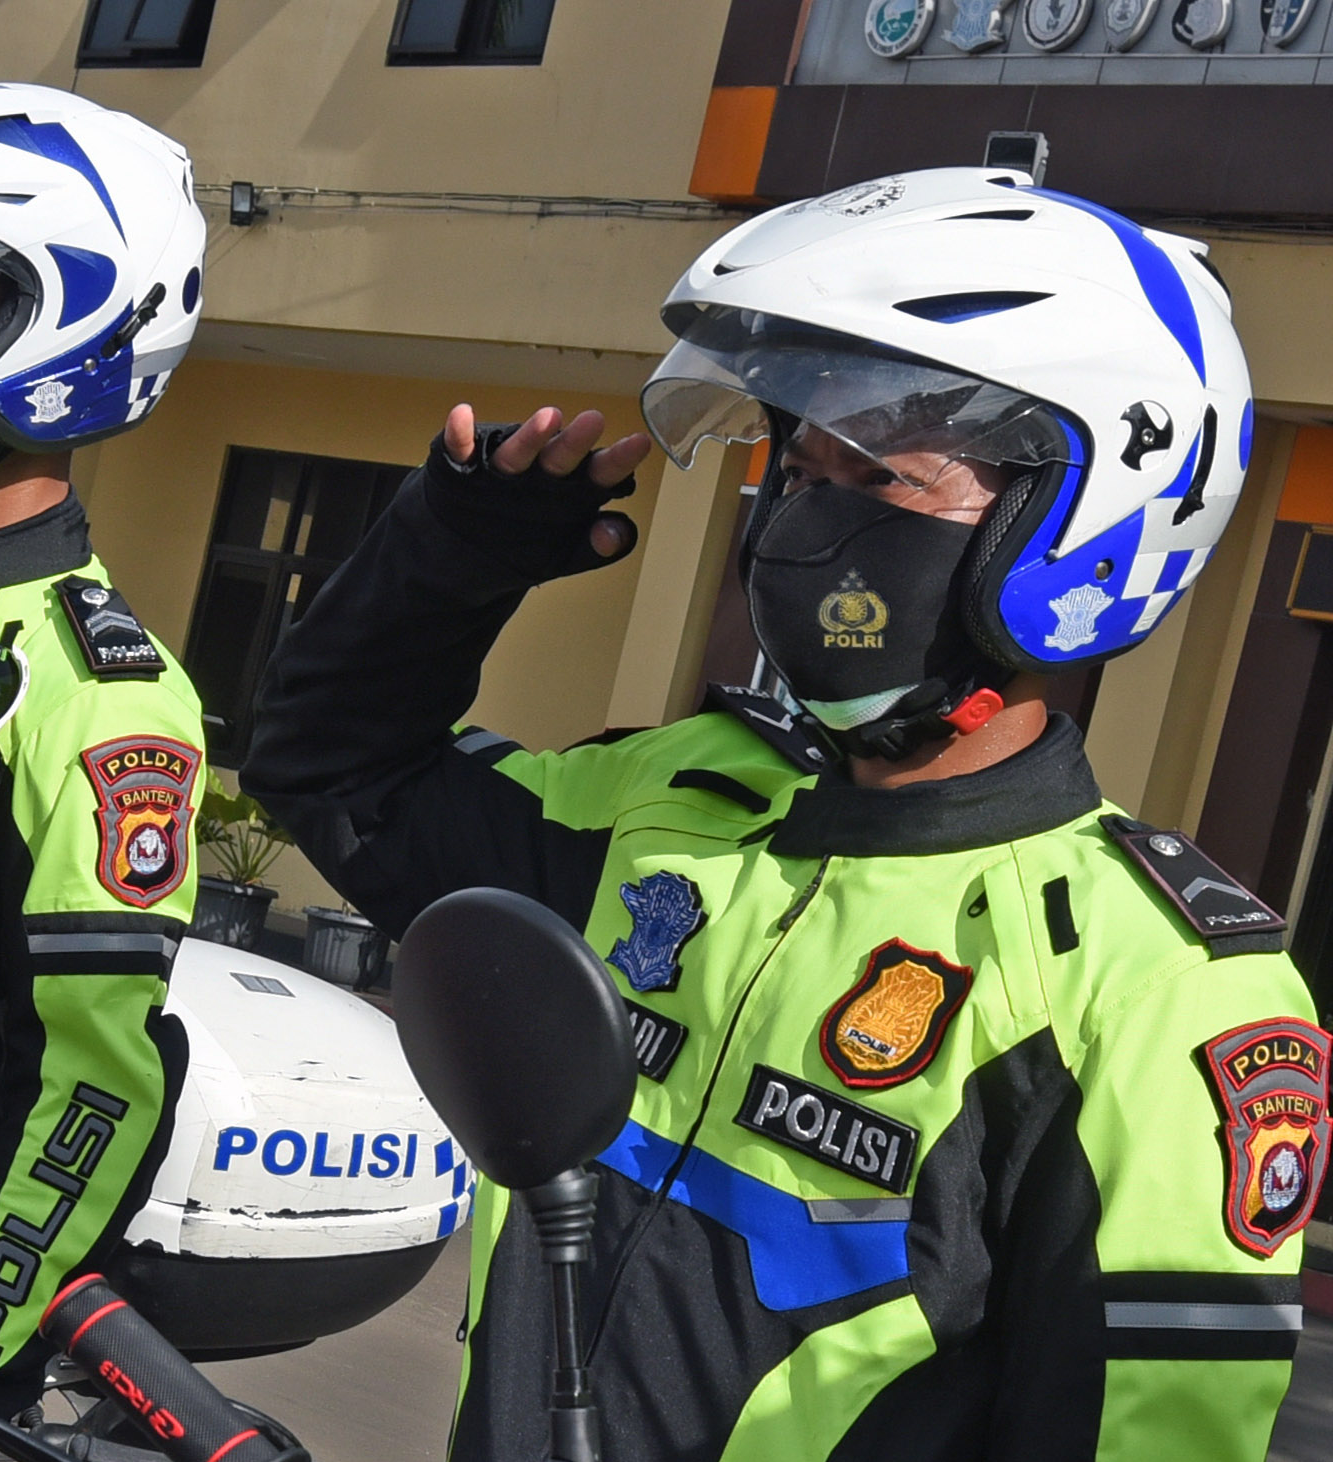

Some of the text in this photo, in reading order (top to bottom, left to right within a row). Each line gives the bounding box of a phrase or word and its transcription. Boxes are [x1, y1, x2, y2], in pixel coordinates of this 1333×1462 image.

[823, 632, 885, 650] POLRI
[106, 750, 182, 777] POLDA
[122, 789, 175, 807] BANTEN
[1231, 1038, 1318, 1081] POLDA
[1252, 1094, 1315, 1118] BANTEN
[751, 1080, 903, 1182] POLISI
[212, 1125, 419, 1179] POLISI
